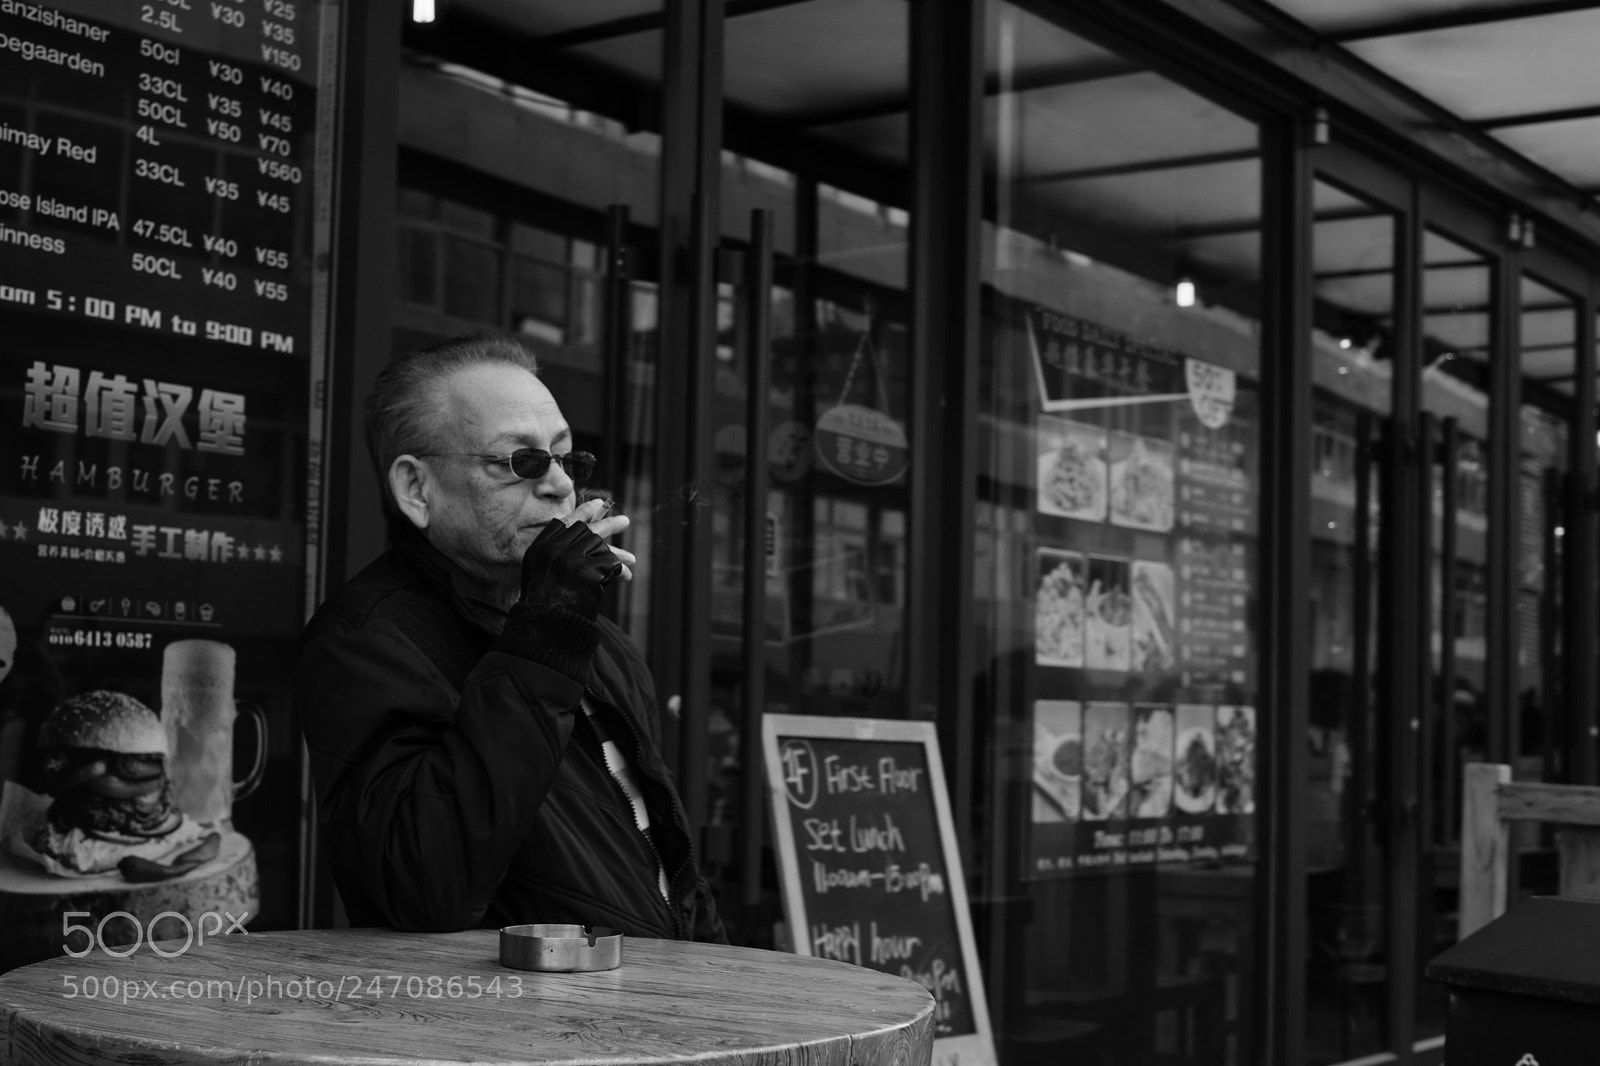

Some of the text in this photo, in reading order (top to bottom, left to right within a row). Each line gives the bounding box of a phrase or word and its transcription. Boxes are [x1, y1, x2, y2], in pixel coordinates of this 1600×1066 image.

[141, 5, 301, 71] 2.5L ¥150
[211, 2, 245, 28] ¥30
[261, 20, 295, 45] ¥35
[138, 73, 188, 102] 33CL
[207, 93, 242, 118] ¥35
[259, 109, 292, 133] ¥45
[208, 60, 243, 85] ¥30
[259, 76, 293, 100] ¥40
[137, 99, 291, 156] 50CL ¥50 ¥70
[0, 122, 290, 213] imay Red 33CL ¥35 ¥45
[136, 125, 302, 184] 4L ¥560
[36, 195, 87, 224] Island
[92, 207, 120, 231] IPA
[132, 219, 192, 248] 47.5CL
[203, 234, 238, 258] ¥40
[255, 246, 289, 269] ¥55
[132, 253, 182, 280] 50CL
[201, 268, 237, 291] ¥40
[254, 279, 288, 302] ¥55
[125, 305, 161, 329] PM
[171, 315, 197, 336] to
[205, 321, 252, 346] 9:00
[260, 331, 294, 354] PM
[22, 361, 247, 457] 超值汉堡
[20, 455, 244, 503] HAMBURGER
[37, 507, 127, 540] 极度诱惑
[131, 524, 236, 563] 手工制作
[803, 818, 847, 853] Set
